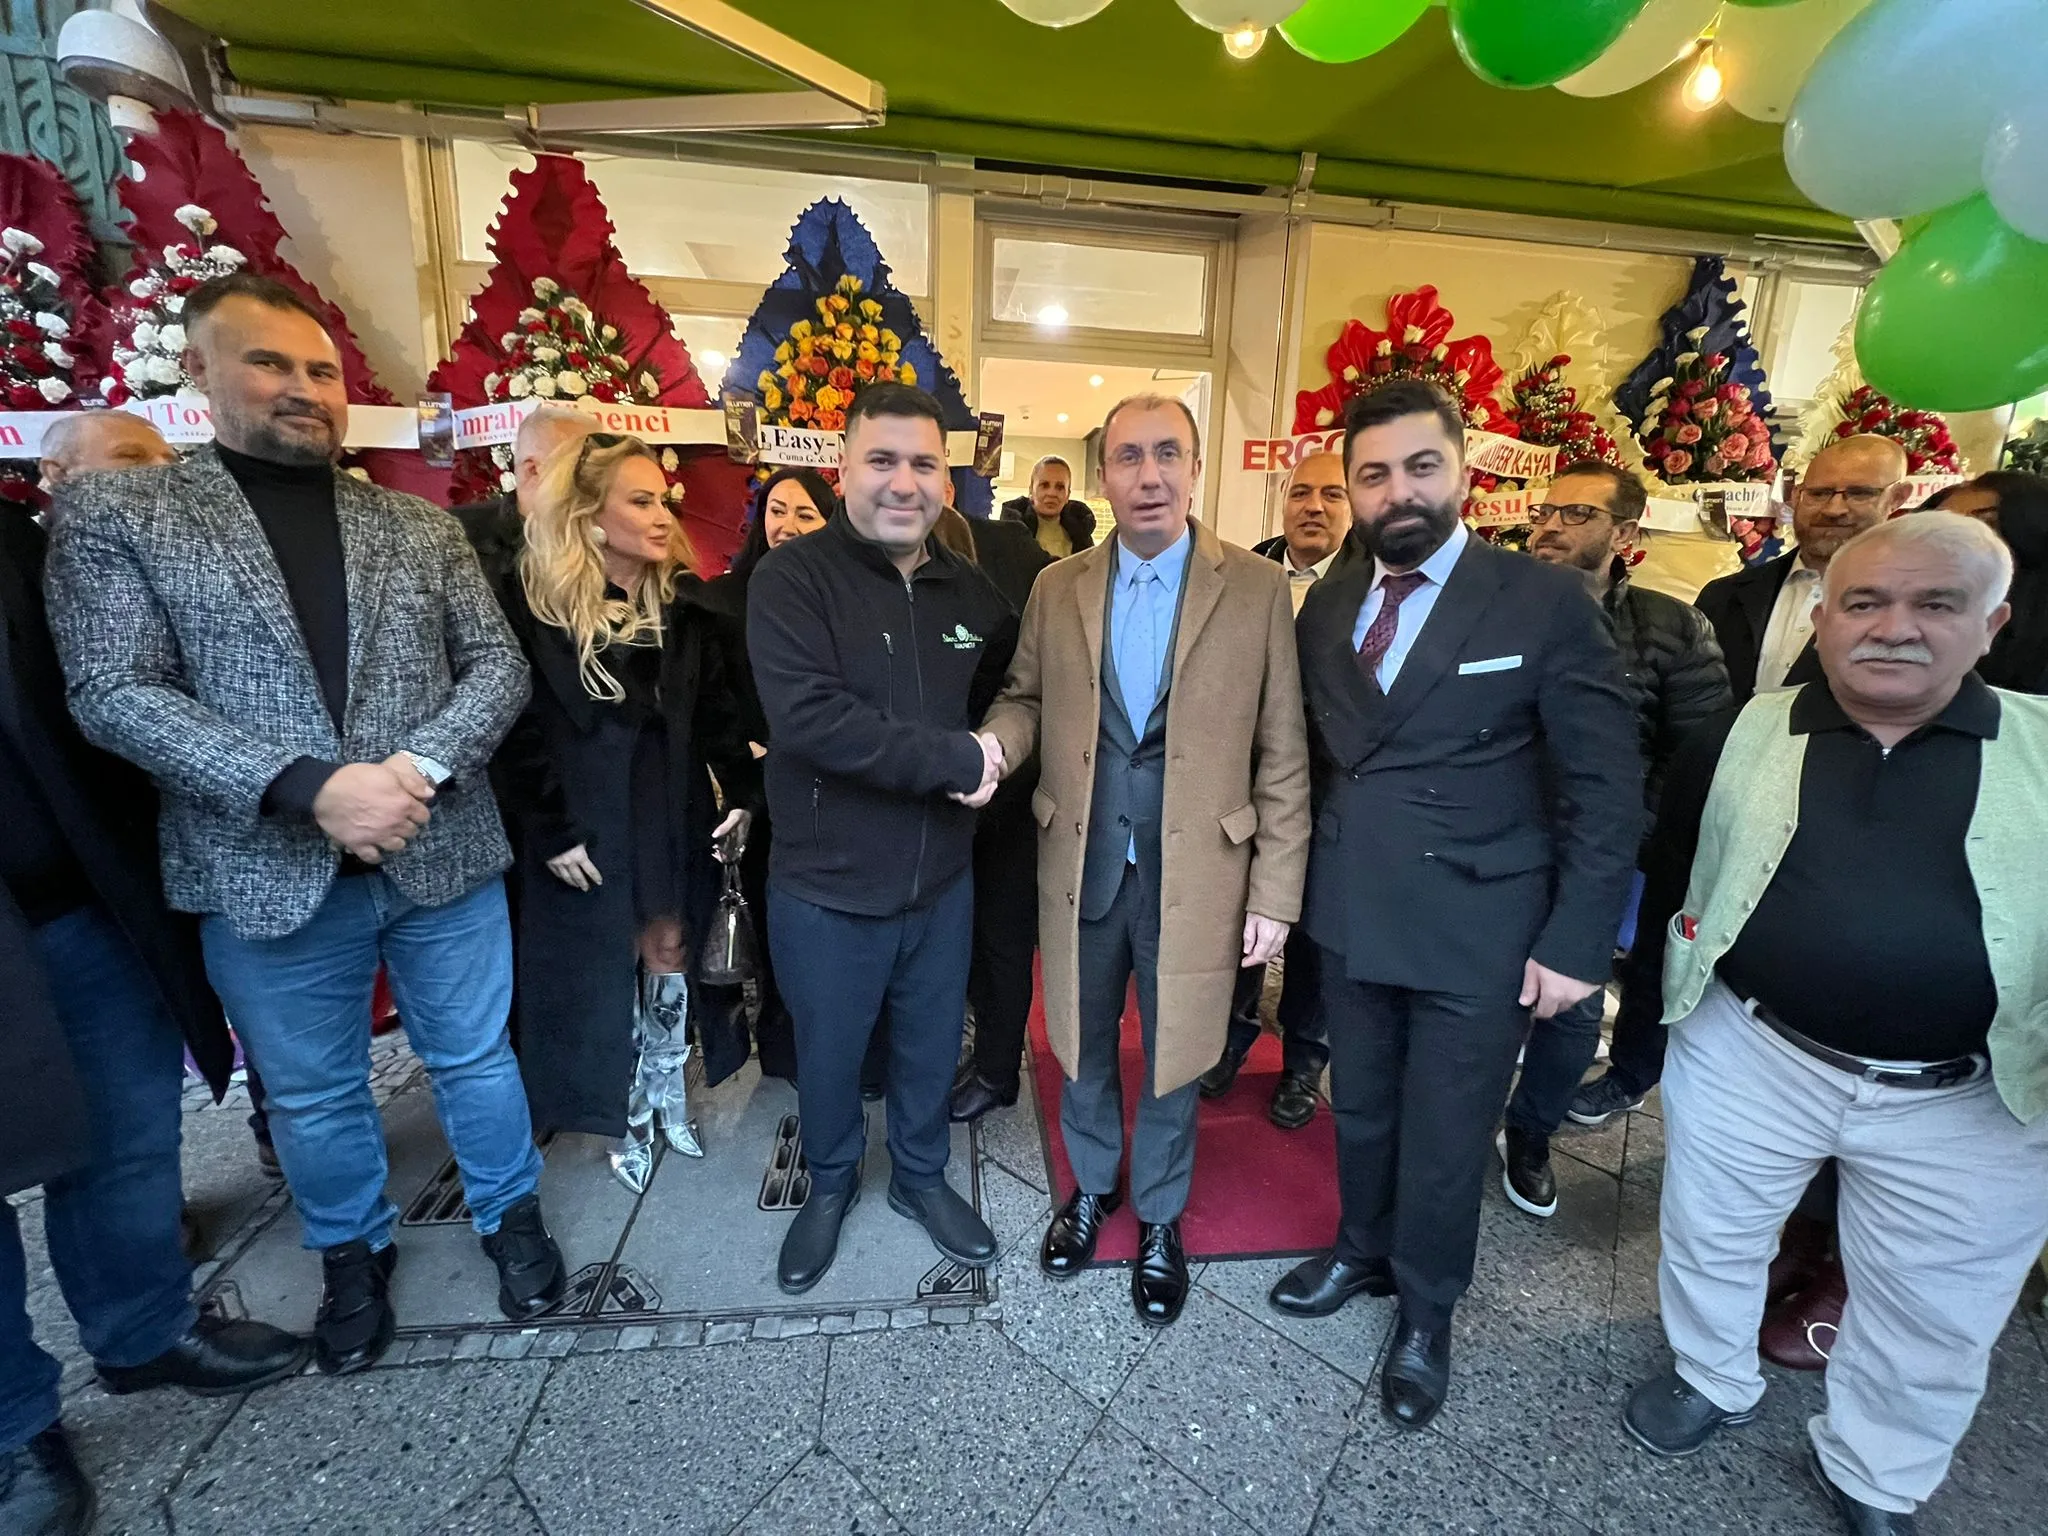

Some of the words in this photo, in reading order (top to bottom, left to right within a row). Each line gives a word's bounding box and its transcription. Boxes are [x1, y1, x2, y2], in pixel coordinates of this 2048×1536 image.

[454, 403, 524, 437] mrah
[590, 407, 670, 433] enci
[779, 451, 804, 462] Cuma
[1510, 449, 1551, 477] KAYA
[1473, 491, 1532, 517] esul
